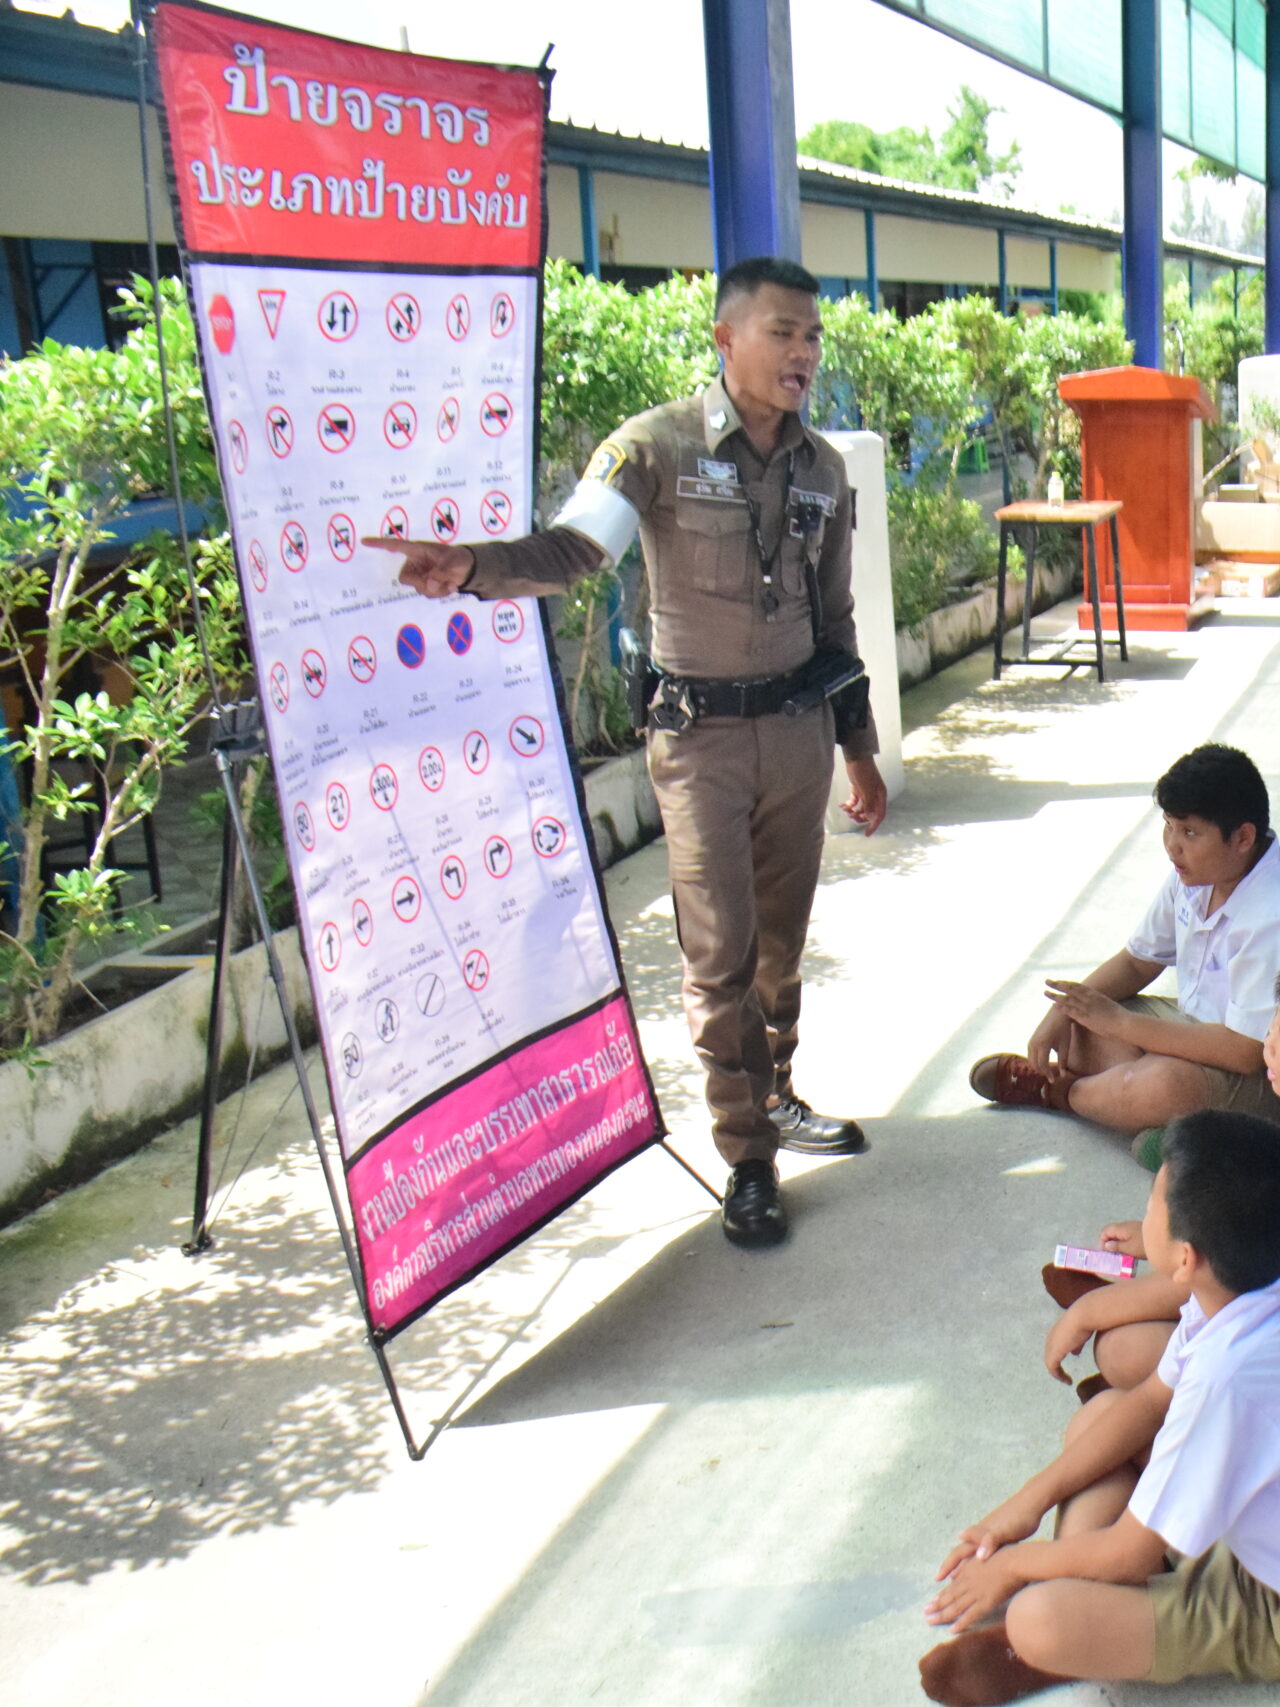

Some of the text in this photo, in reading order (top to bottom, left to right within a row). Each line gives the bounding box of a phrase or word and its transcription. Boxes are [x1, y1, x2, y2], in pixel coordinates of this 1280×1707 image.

[223, 42, 489, 147] ป้ายจราจร
[191, 145, 528, 228] ประเภทป้ายบังคับ
[361, 1019, 634, 1242] งานป้องกันและบรรเทาสาธารณภัย
